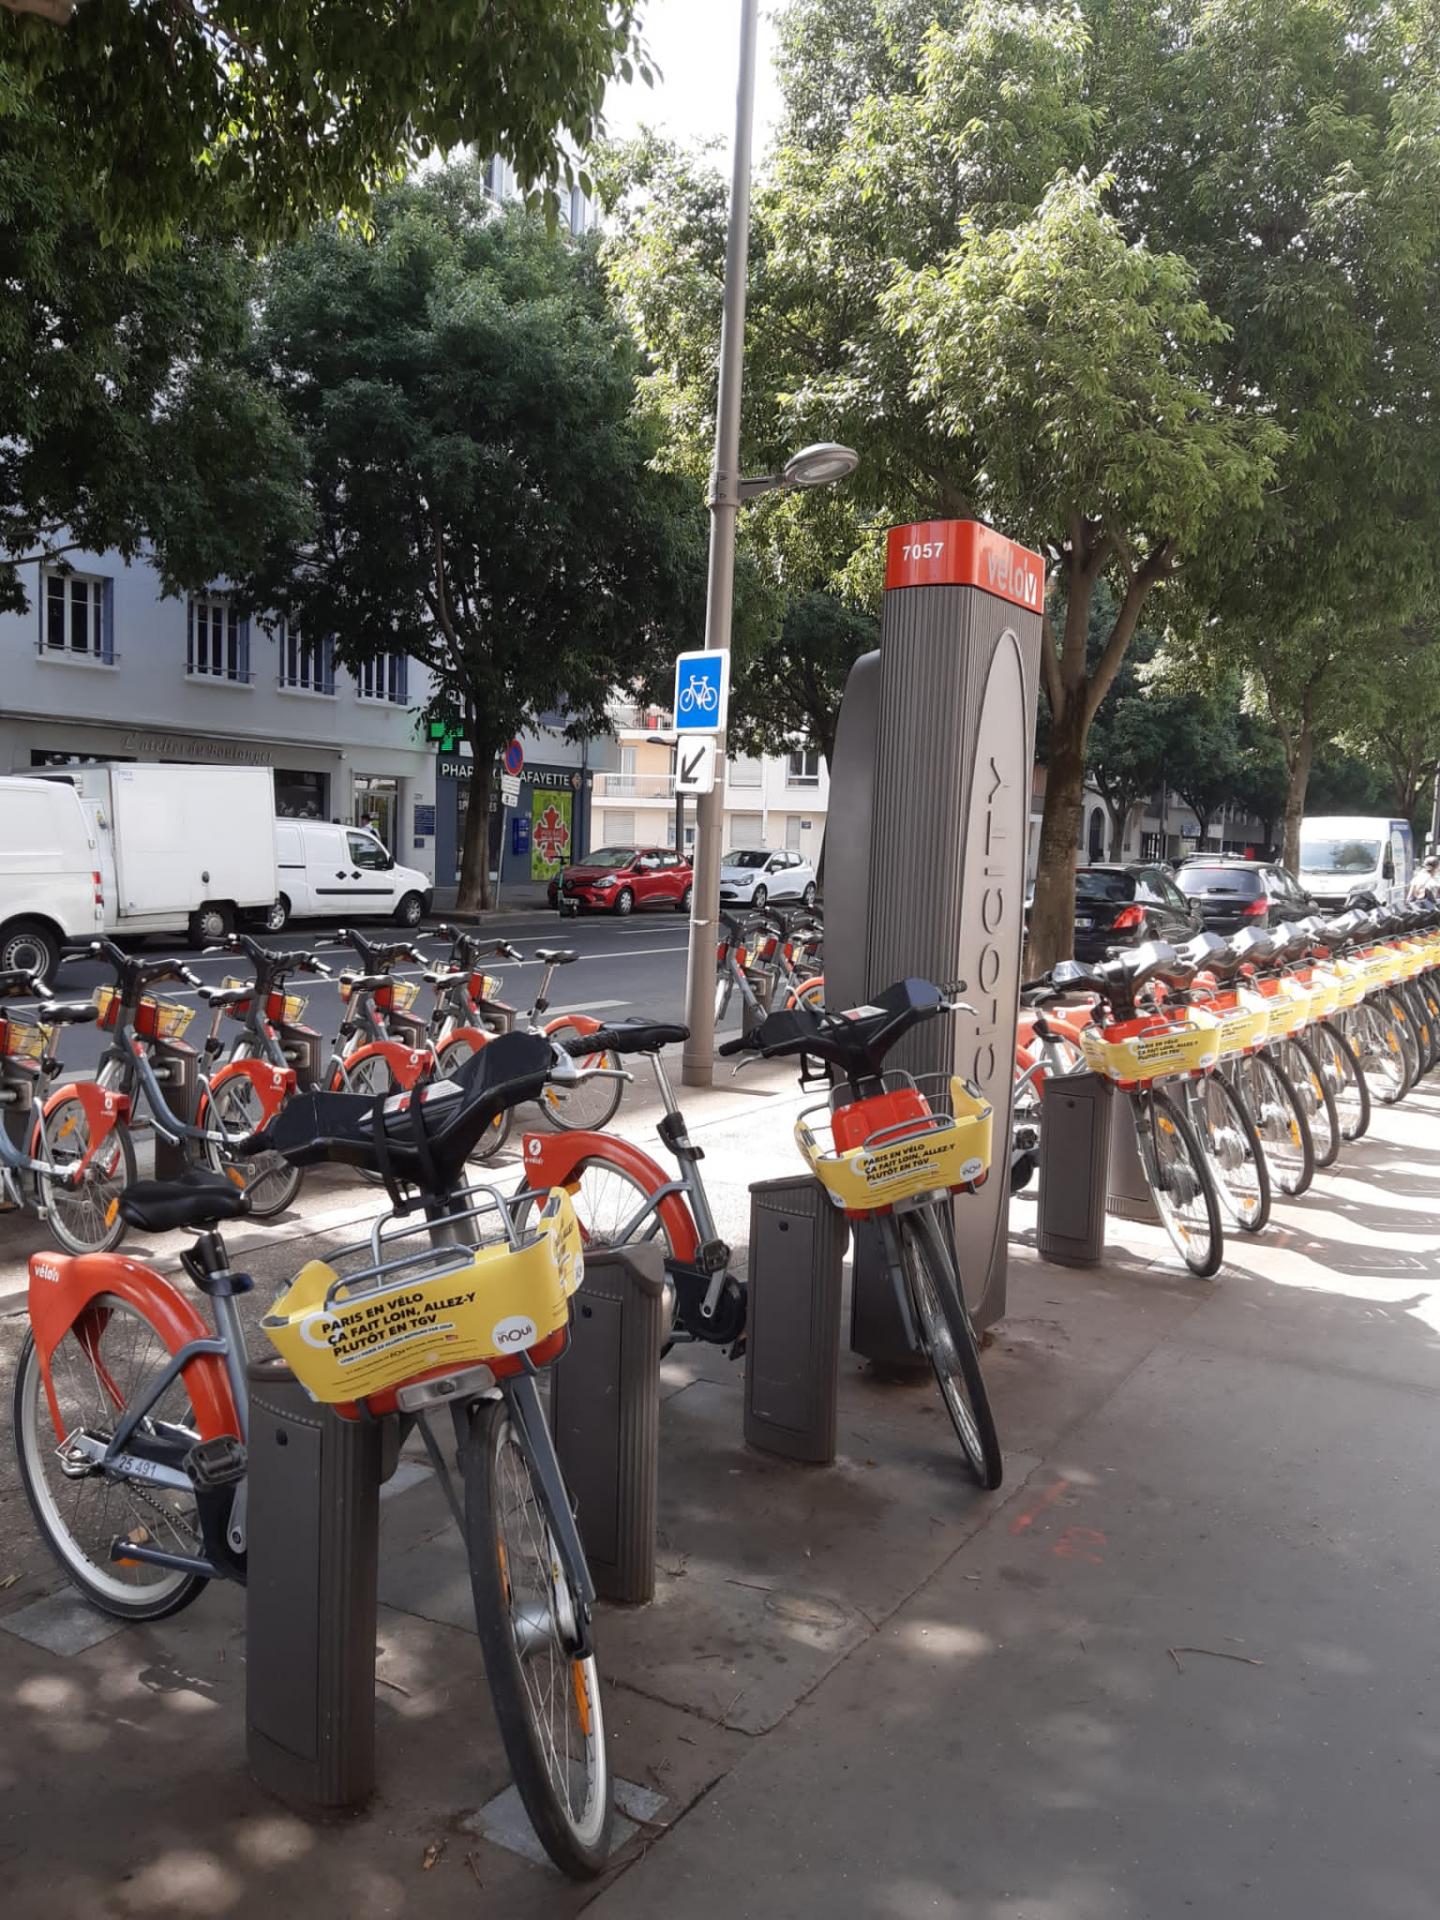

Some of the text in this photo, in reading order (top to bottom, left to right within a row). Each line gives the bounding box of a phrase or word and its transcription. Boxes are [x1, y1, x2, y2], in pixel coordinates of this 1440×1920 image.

[902, 542, 944, 561] 7057
[519, 771, 570, 786] AFAYETTE
[863, 1154, 889, 1167] PARIS
[889, 1150, 901, 1159] EN
[879, 1158, 897, 1169] FAIT
[899, 1162, 911, 1172] EN
[912, 1157, 930, 1168] TGV
[322, 1292, 424, 1334] PARIS EN VÉLO
[327, 1292, 476, 1349] ÇA FAIT LOIN, ALLEZ-Y
[333, 1315, 437, 1357] PLUTÔT EN TGV
